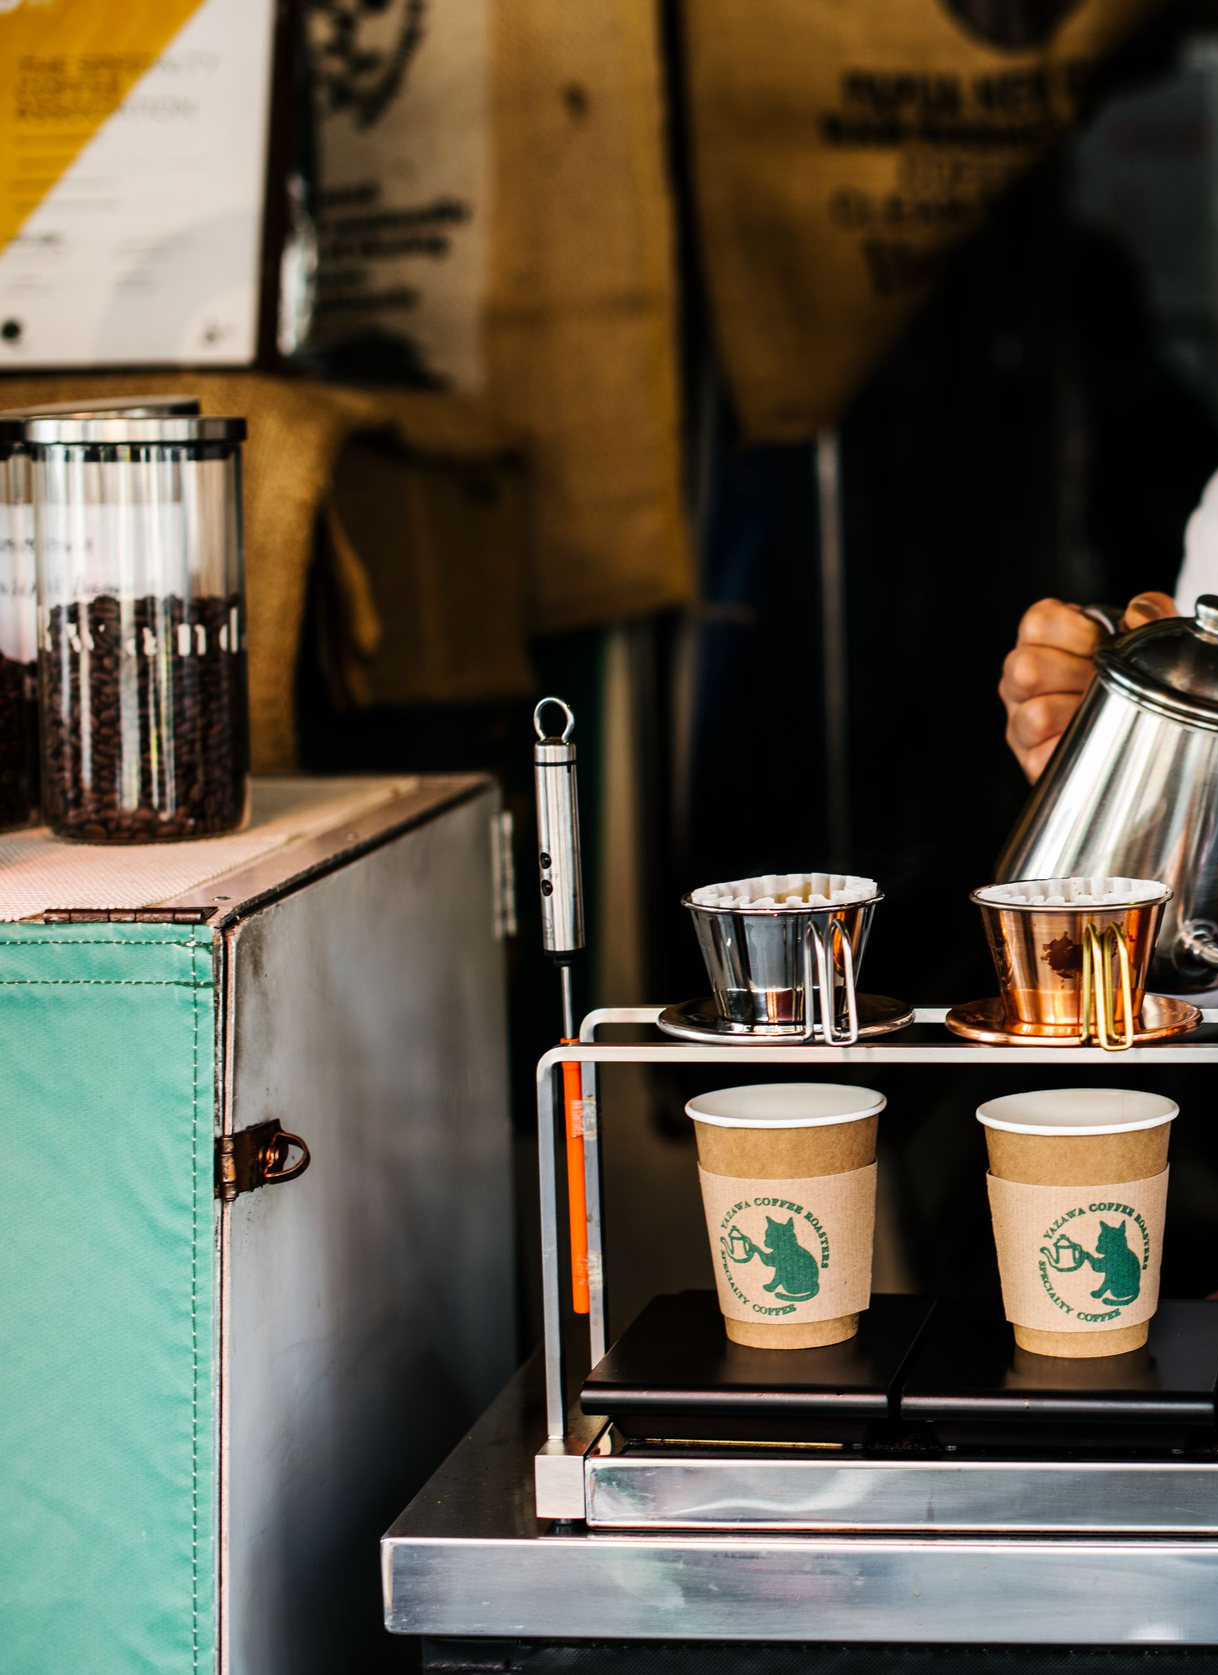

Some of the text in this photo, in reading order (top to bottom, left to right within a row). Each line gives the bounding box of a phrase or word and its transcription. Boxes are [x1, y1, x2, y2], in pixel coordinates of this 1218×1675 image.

[721, 1197, 830, 1269] YAZAWA COFFEE ROASTERS
[1043, 1202, 1151, 1270] YAZAWA COFFEE ROASTERS
[721, 1250, 797, 1316] SPECIALTY COFFEE
[1038, 1260, 1121, 1322] SPECIALTY COFFEE
